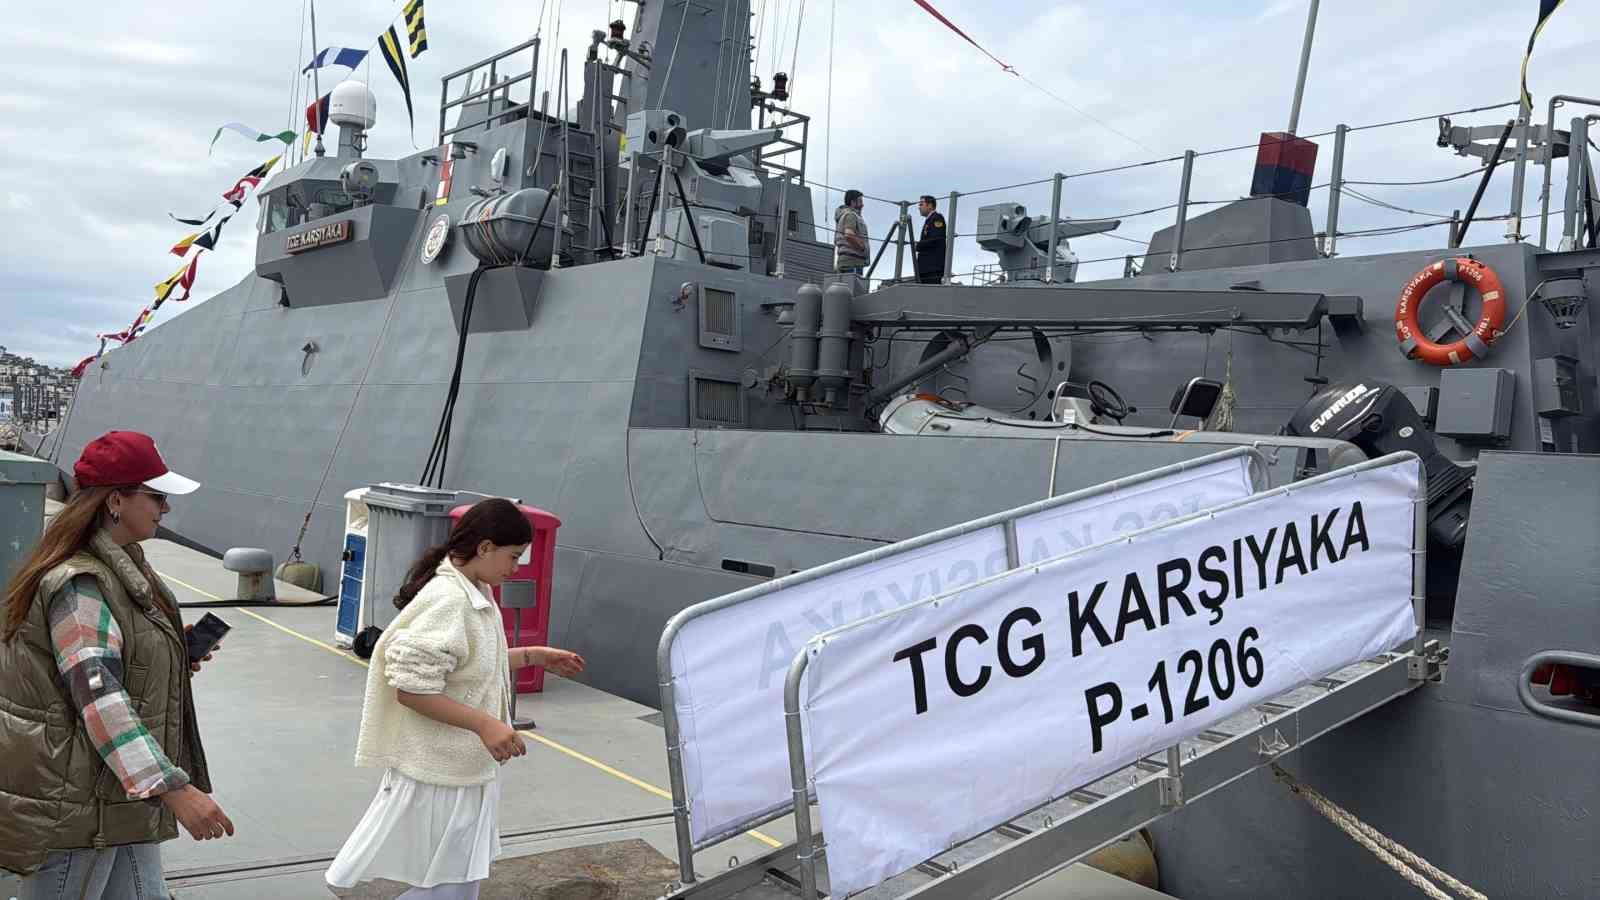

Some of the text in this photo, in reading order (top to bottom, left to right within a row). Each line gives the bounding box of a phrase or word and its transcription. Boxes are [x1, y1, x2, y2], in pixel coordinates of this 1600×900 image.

[1309, 383, 1368, 433] EVINRUDE
[893, 501, 1370, 715] TCG KARŞIYAKA
[1084, 626, 1265, 754] P-1206
